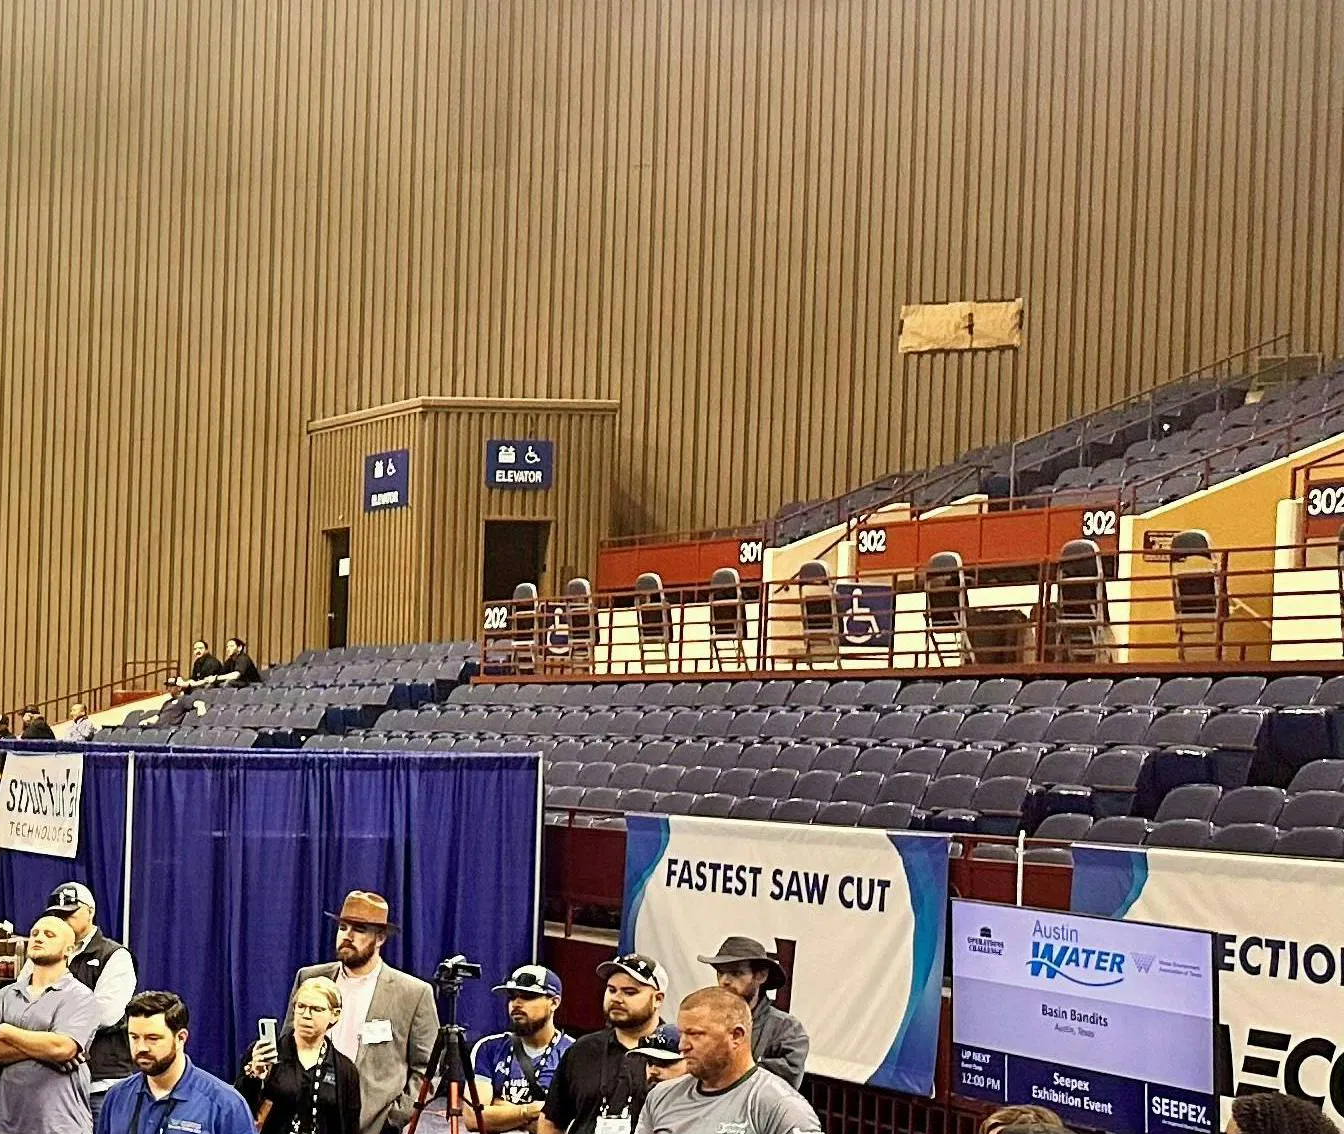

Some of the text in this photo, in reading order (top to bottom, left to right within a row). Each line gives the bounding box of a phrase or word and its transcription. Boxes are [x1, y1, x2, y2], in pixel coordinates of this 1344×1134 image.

[495, 469, 543, 483] ELEVATOR
[1307, 486, 1344, 515] 302
[1082, 511, 1116, 536] 302
[739, 541, 763, 564] 301
[858, 529, 887, 553] 302
[483, 607, 508, 629] 202
[665, 858, 891, 912] FASTEST SAW CUT
[1032, 919, 1079, 943] Austin
[1028, 941, 1125, 979] WATER
[1041, 1003, 1109, 1028] Basin Bandits
[961, 1049, 991, 1064] UP NEXT
[962, 1072, 1001, 1091] 12:00 PM
[1053, 1072, 1090, 1092] Seepex
[1031, 1085, 1113, 1115] Exhibition Event
